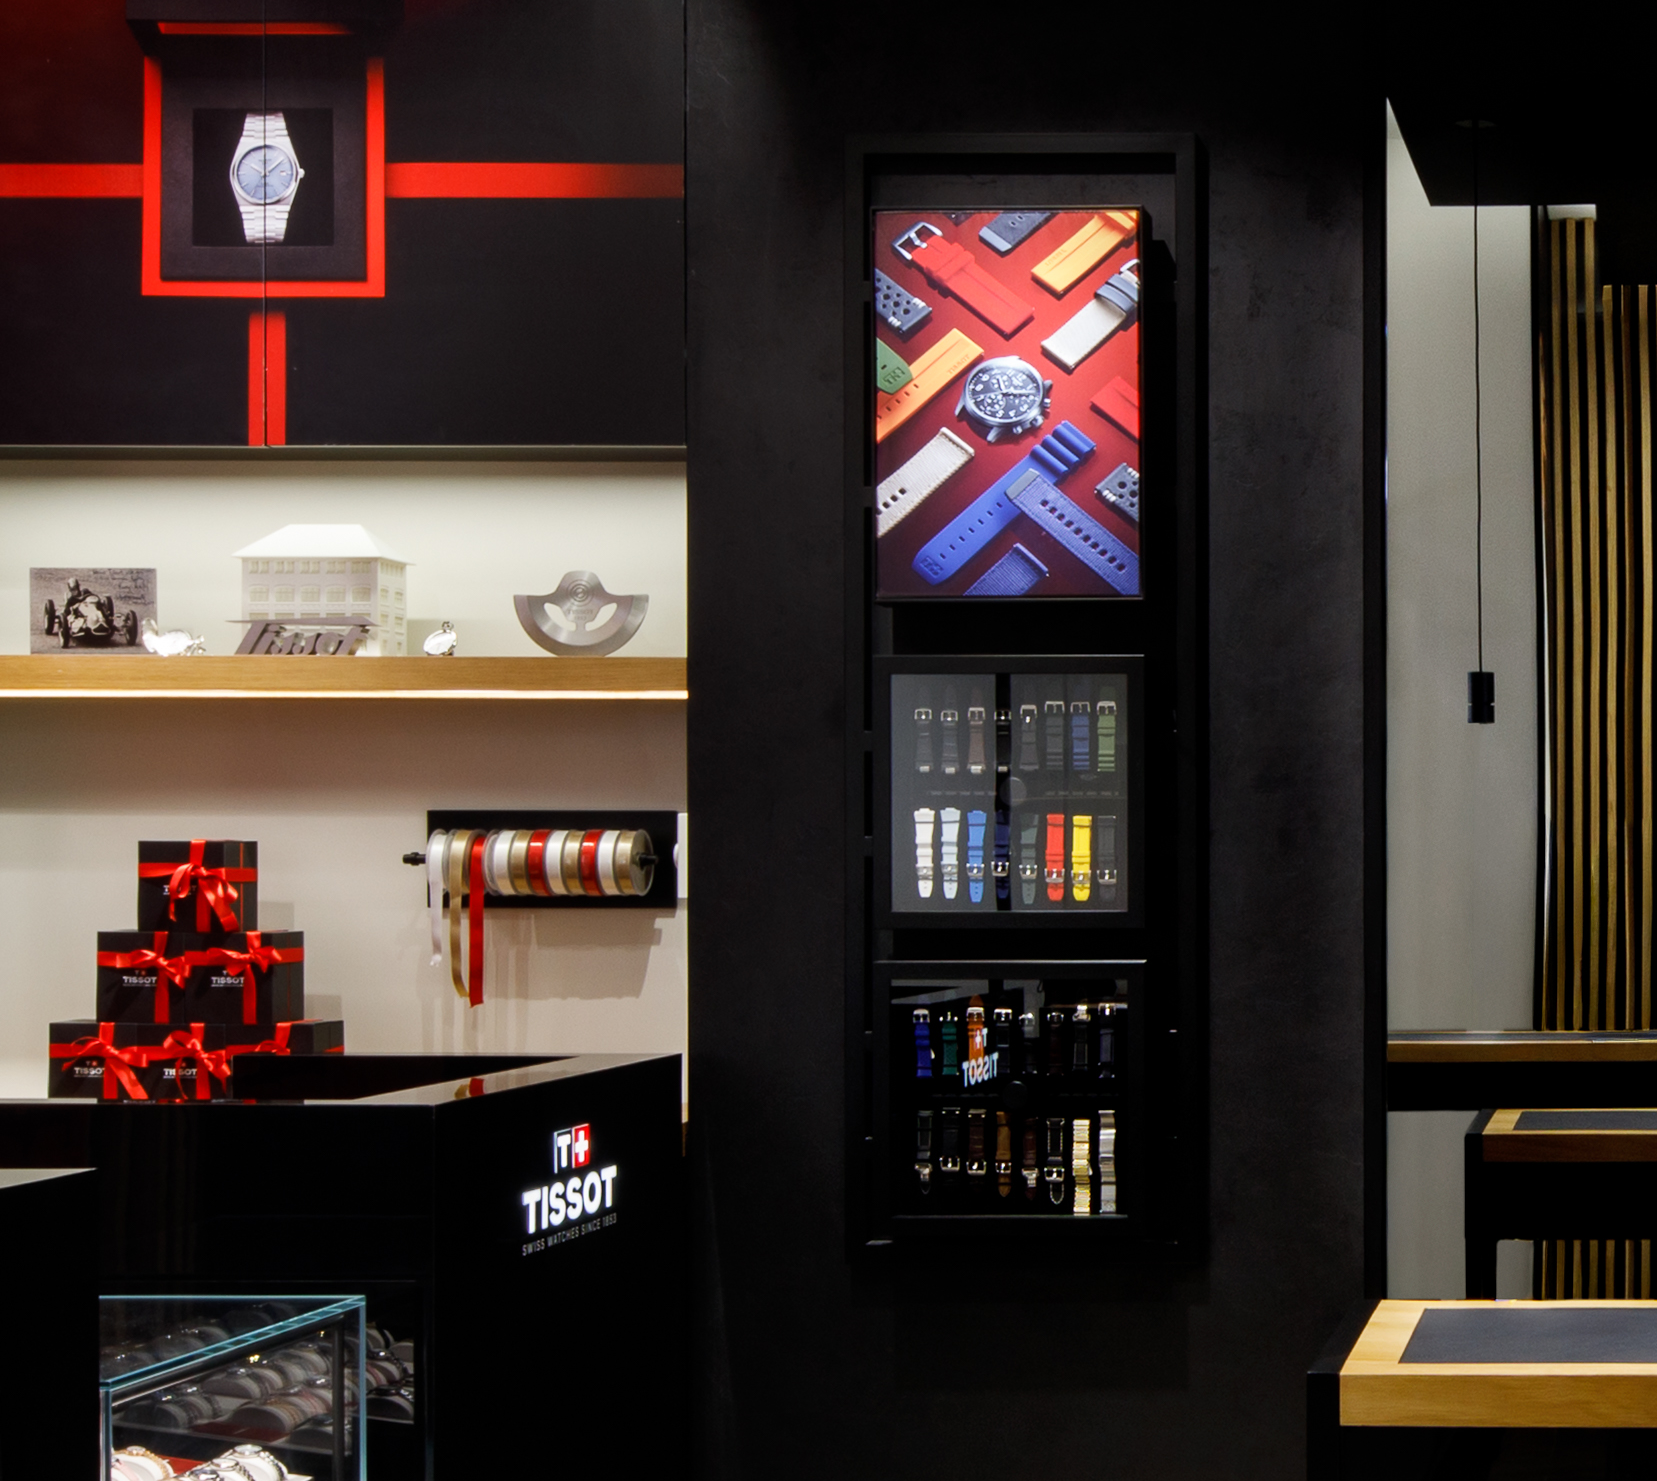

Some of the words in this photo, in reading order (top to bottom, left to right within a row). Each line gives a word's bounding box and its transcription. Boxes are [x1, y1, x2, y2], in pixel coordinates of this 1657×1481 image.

[557, 1133, 571, 1168] T
[522, 1165, 617, 1234] TISSOT
[522, 1238, 545, 1256] SWISS
[547, 1226, 580, 1247] WATCHES
[581, 1218, 601, 1235] SINCE
[602, 1212, 617, 1227] 1853
